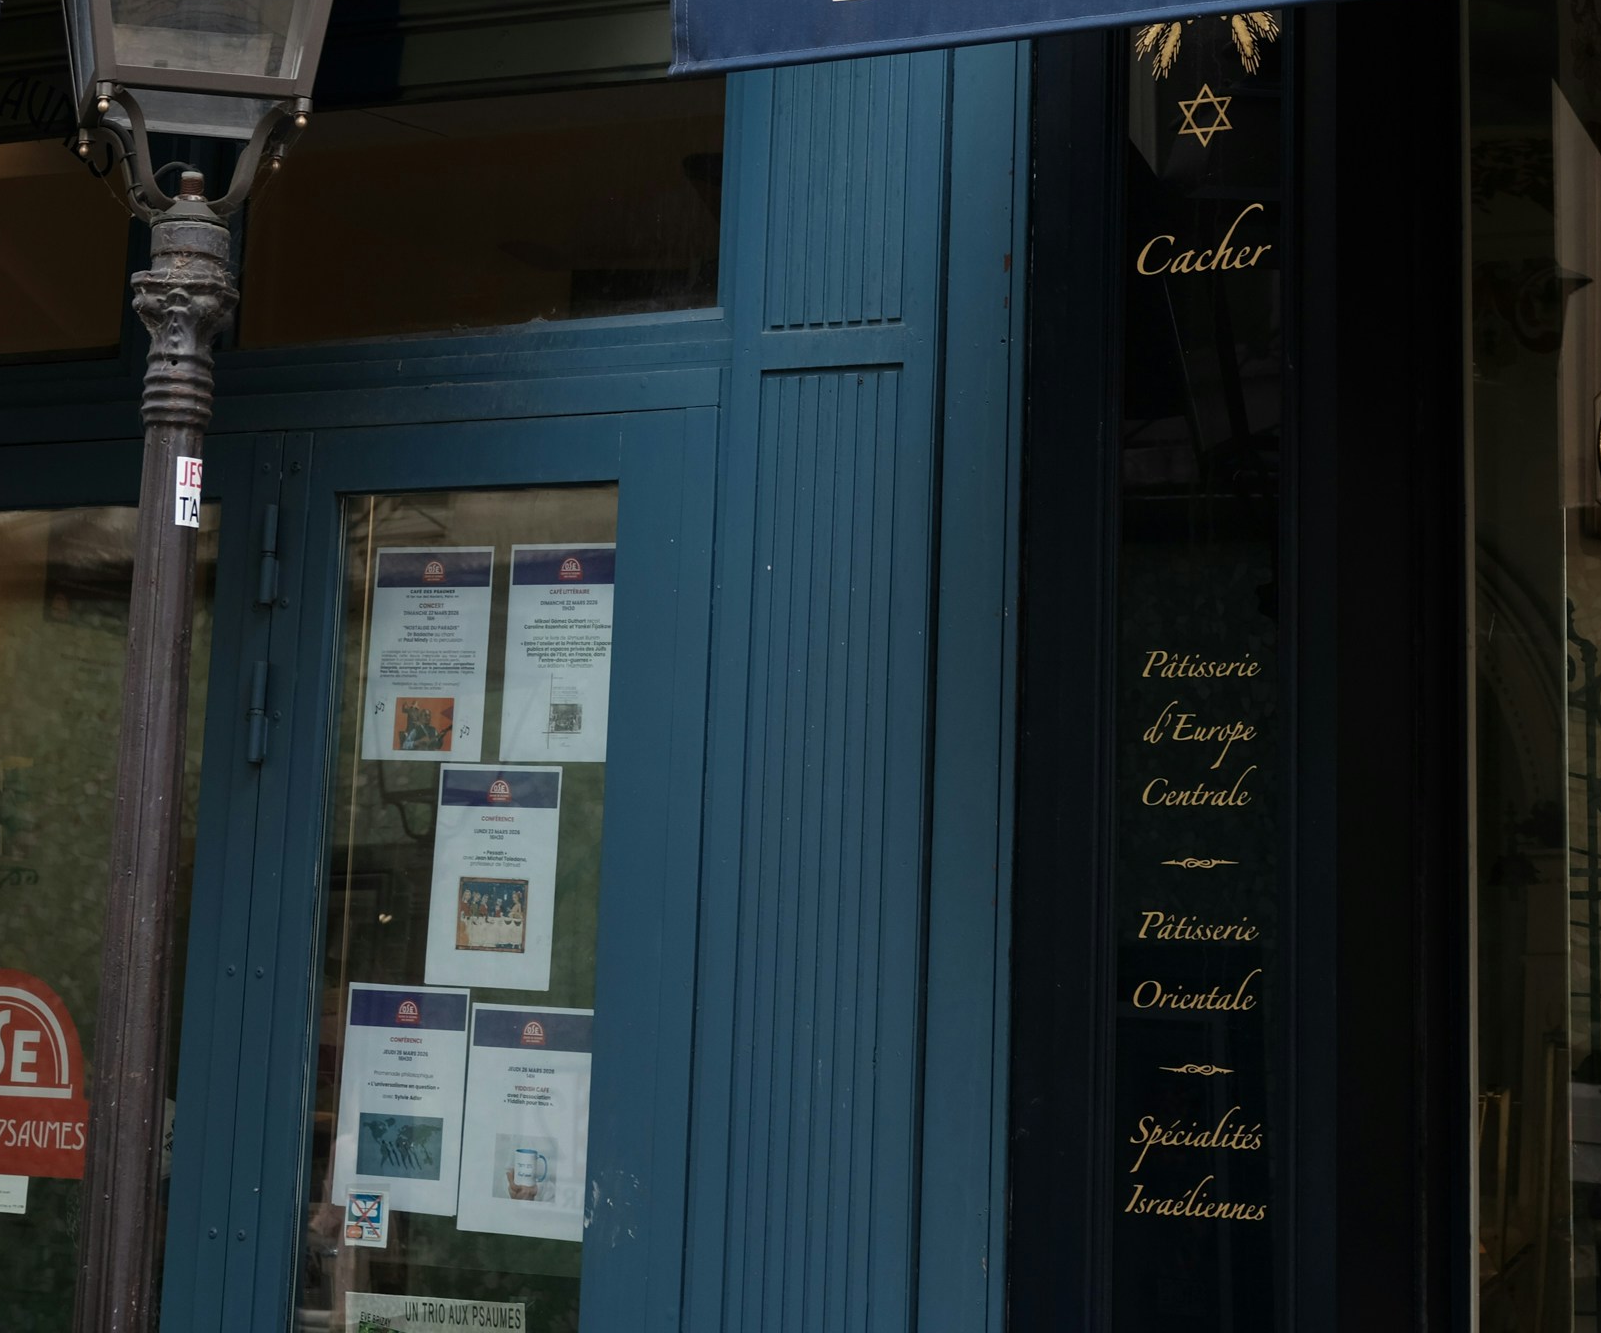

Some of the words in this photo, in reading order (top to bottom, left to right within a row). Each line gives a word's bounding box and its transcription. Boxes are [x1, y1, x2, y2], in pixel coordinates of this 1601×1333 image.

[1136, 202, 1272, 276] Cacher
[1142, 650, 1262, 679] Pâtisserie
[1143, 700, 1257, 770] d'Europe
[1142, 765, 1258, 807] Centrale
[1137, 910, 1260, 942] Pâtisserie
[1132, 968, 1262, 1011] Orientale
[1129, 1105, 1263, 1174] Spécialités
[1124, 1174, 1267, 1222] Israéliennes
[405, 1301, 418, 1322] UN
[422, 1302, 446, 1324] TRIO
[448, 1304, 469, 1326] AUX
[472, 1305, 521, 1330] PSAUMES
